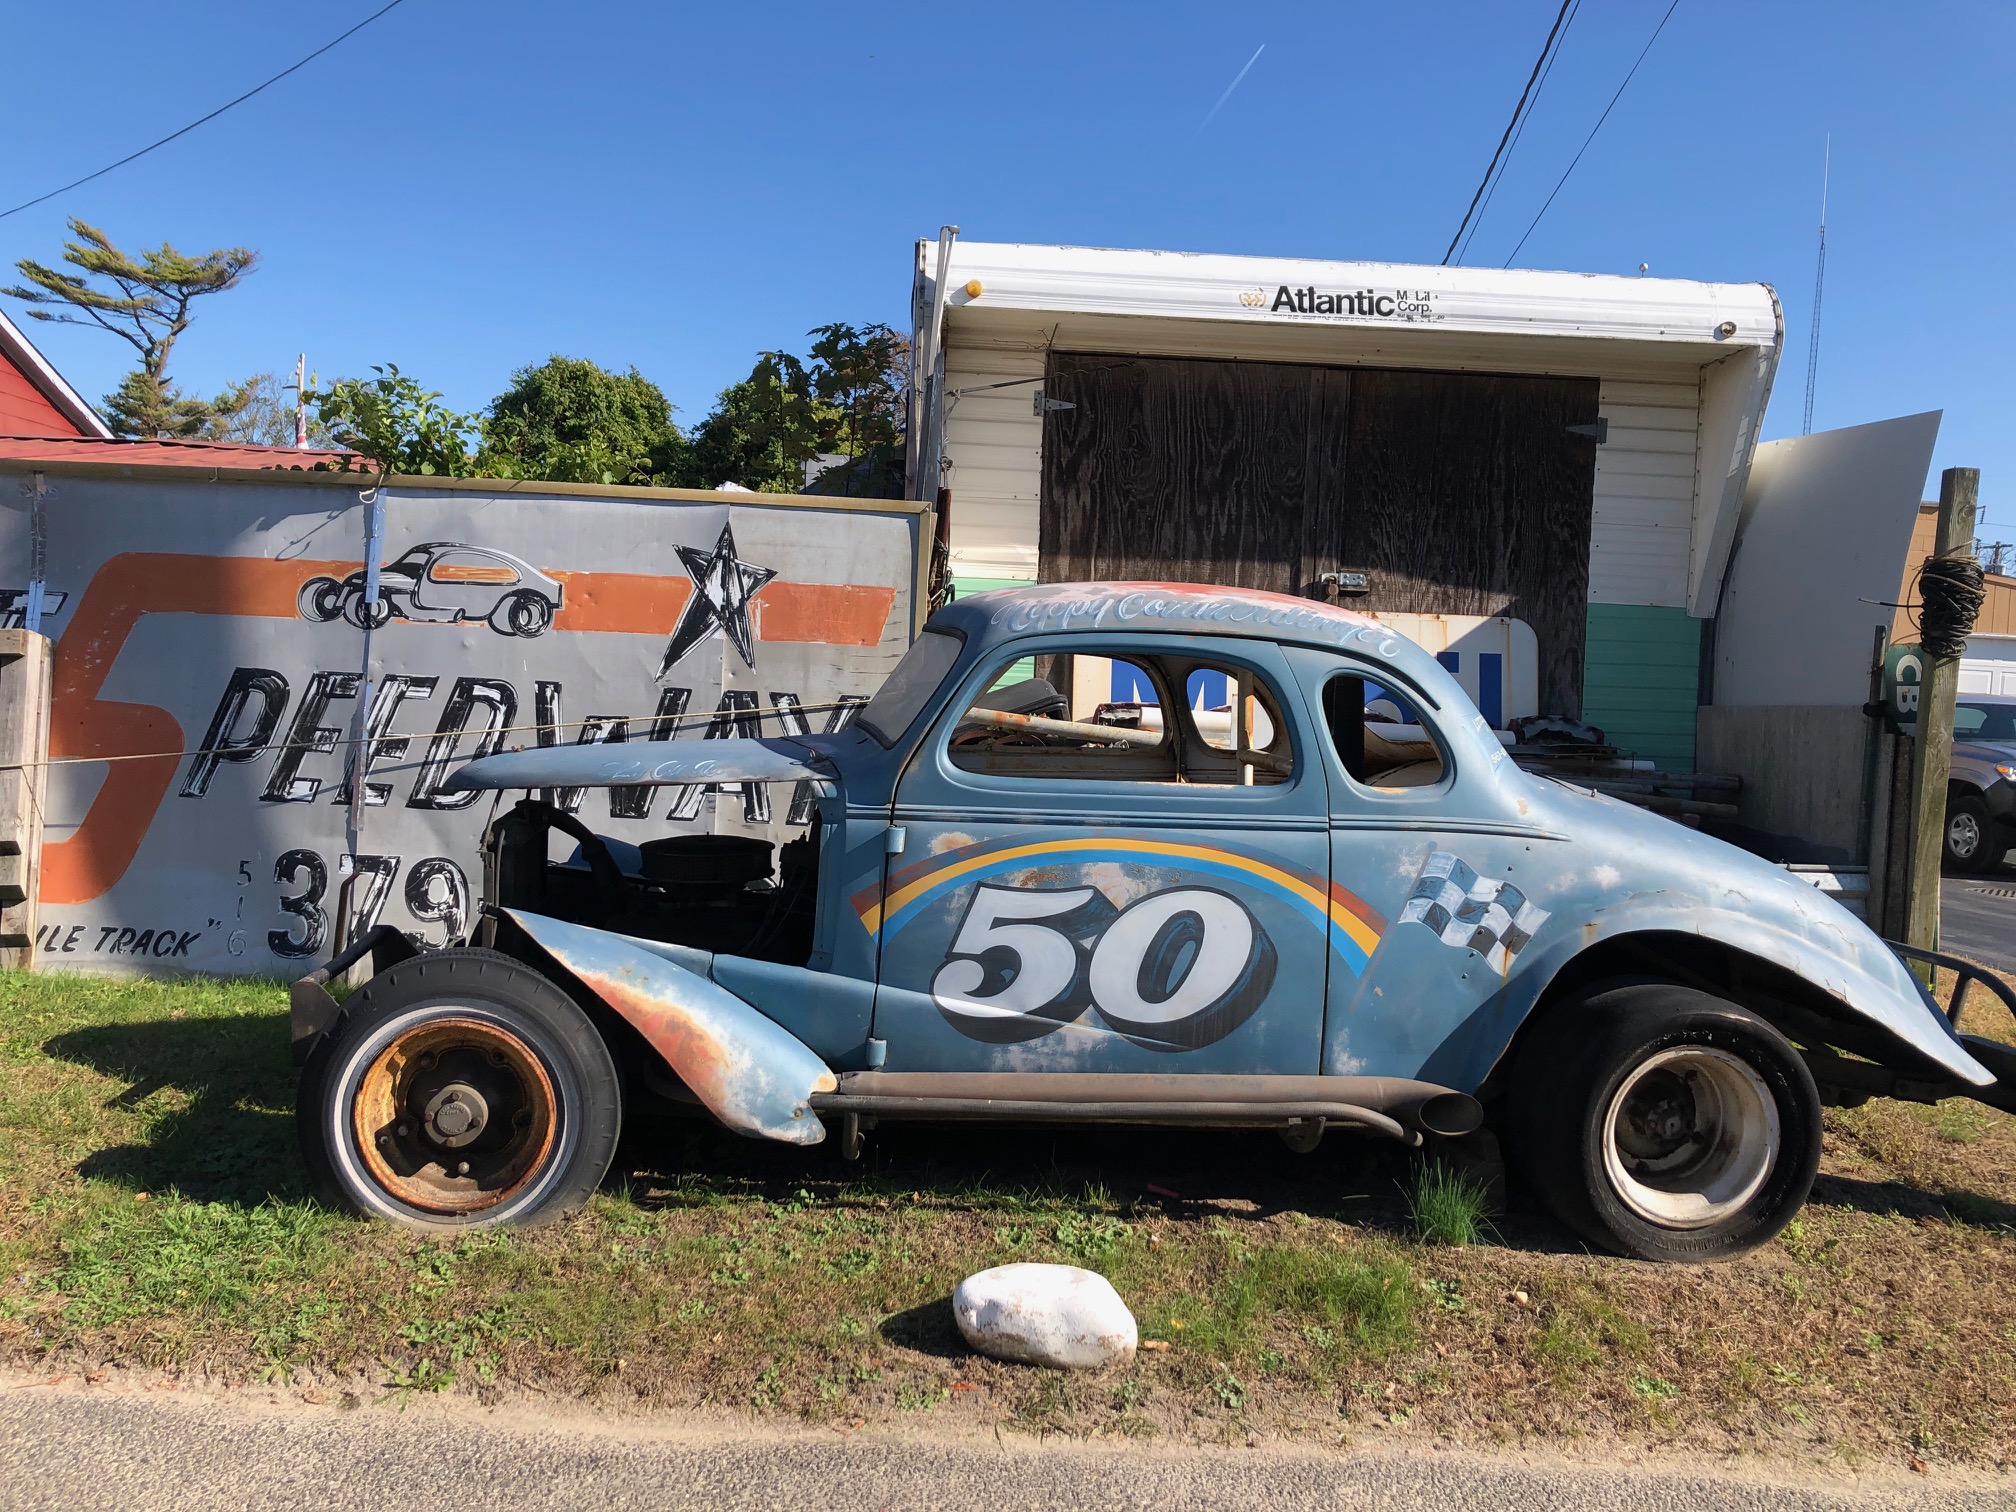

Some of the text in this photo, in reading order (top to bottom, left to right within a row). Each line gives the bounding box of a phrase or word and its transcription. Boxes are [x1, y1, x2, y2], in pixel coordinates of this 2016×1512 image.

[1270, 285, 1396, 317] Atlantic
[1397, 300, 1433, 315] Corp.
[930, 882, 1272, 1046] 50
